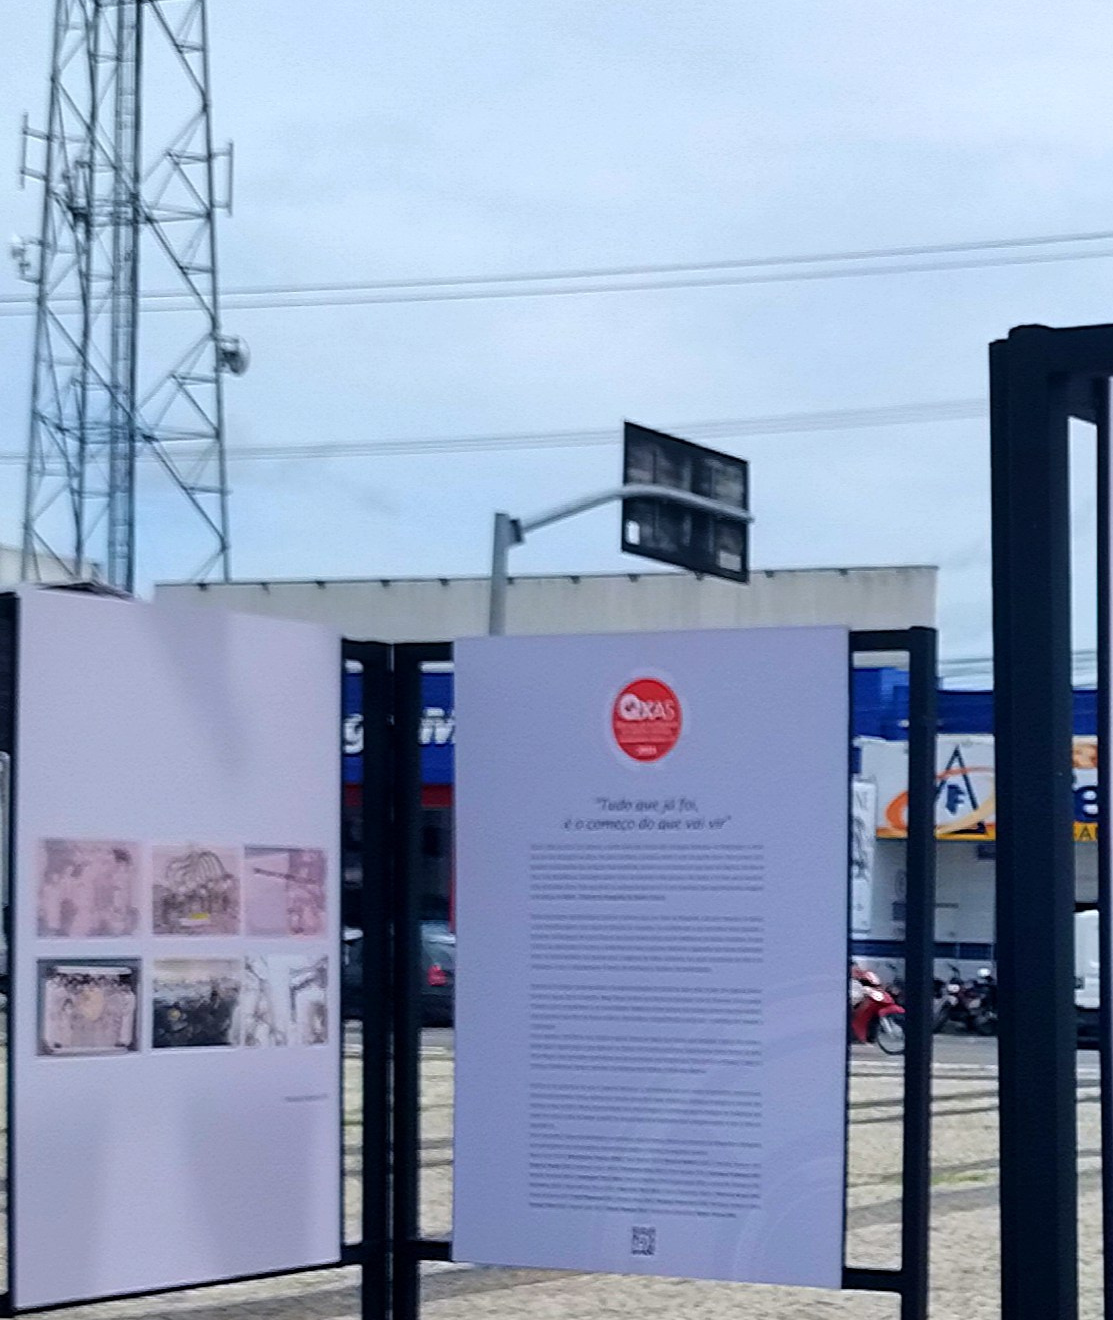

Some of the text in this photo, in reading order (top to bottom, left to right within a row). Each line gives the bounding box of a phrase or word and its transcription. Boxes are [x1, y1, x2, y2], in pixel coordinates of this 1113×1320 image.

[586, 819, 635, 832] começo
[638, 817, 655, 830] do
[658, 820, 681, 832] que
